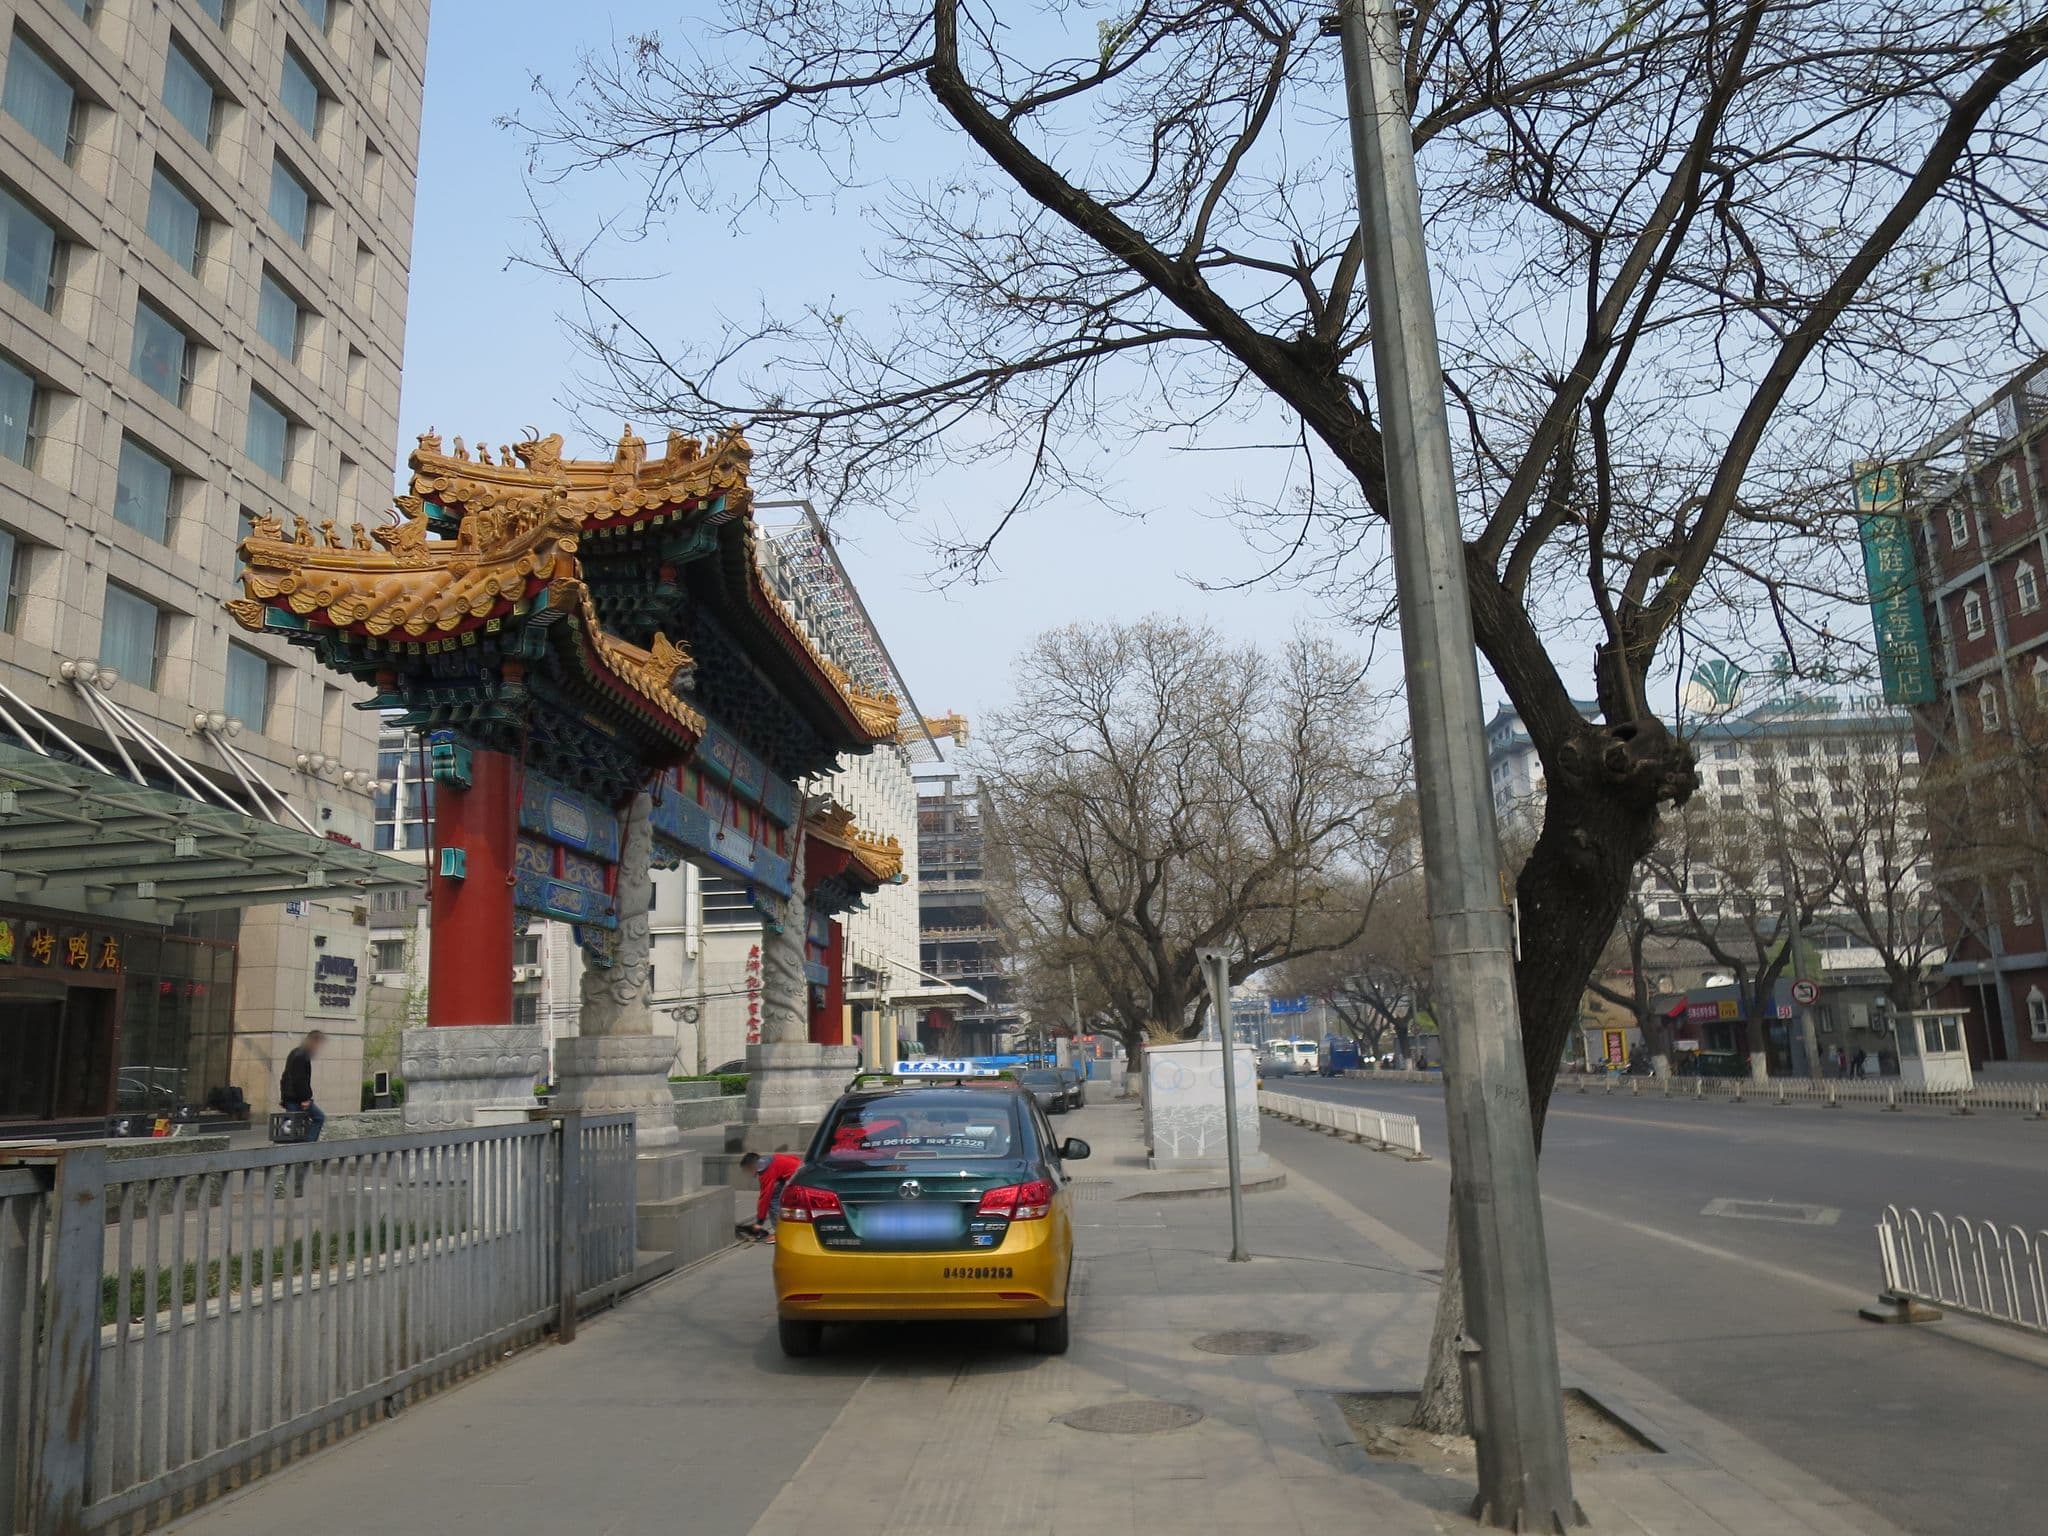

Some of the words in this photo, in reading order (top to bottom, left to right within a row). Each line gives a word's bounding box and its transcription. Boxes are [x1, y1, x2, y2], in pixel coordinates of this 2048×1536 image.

[31, 928, 120, 969] 烤鸭店
[906, 1062, 962, 1070] TAXI
